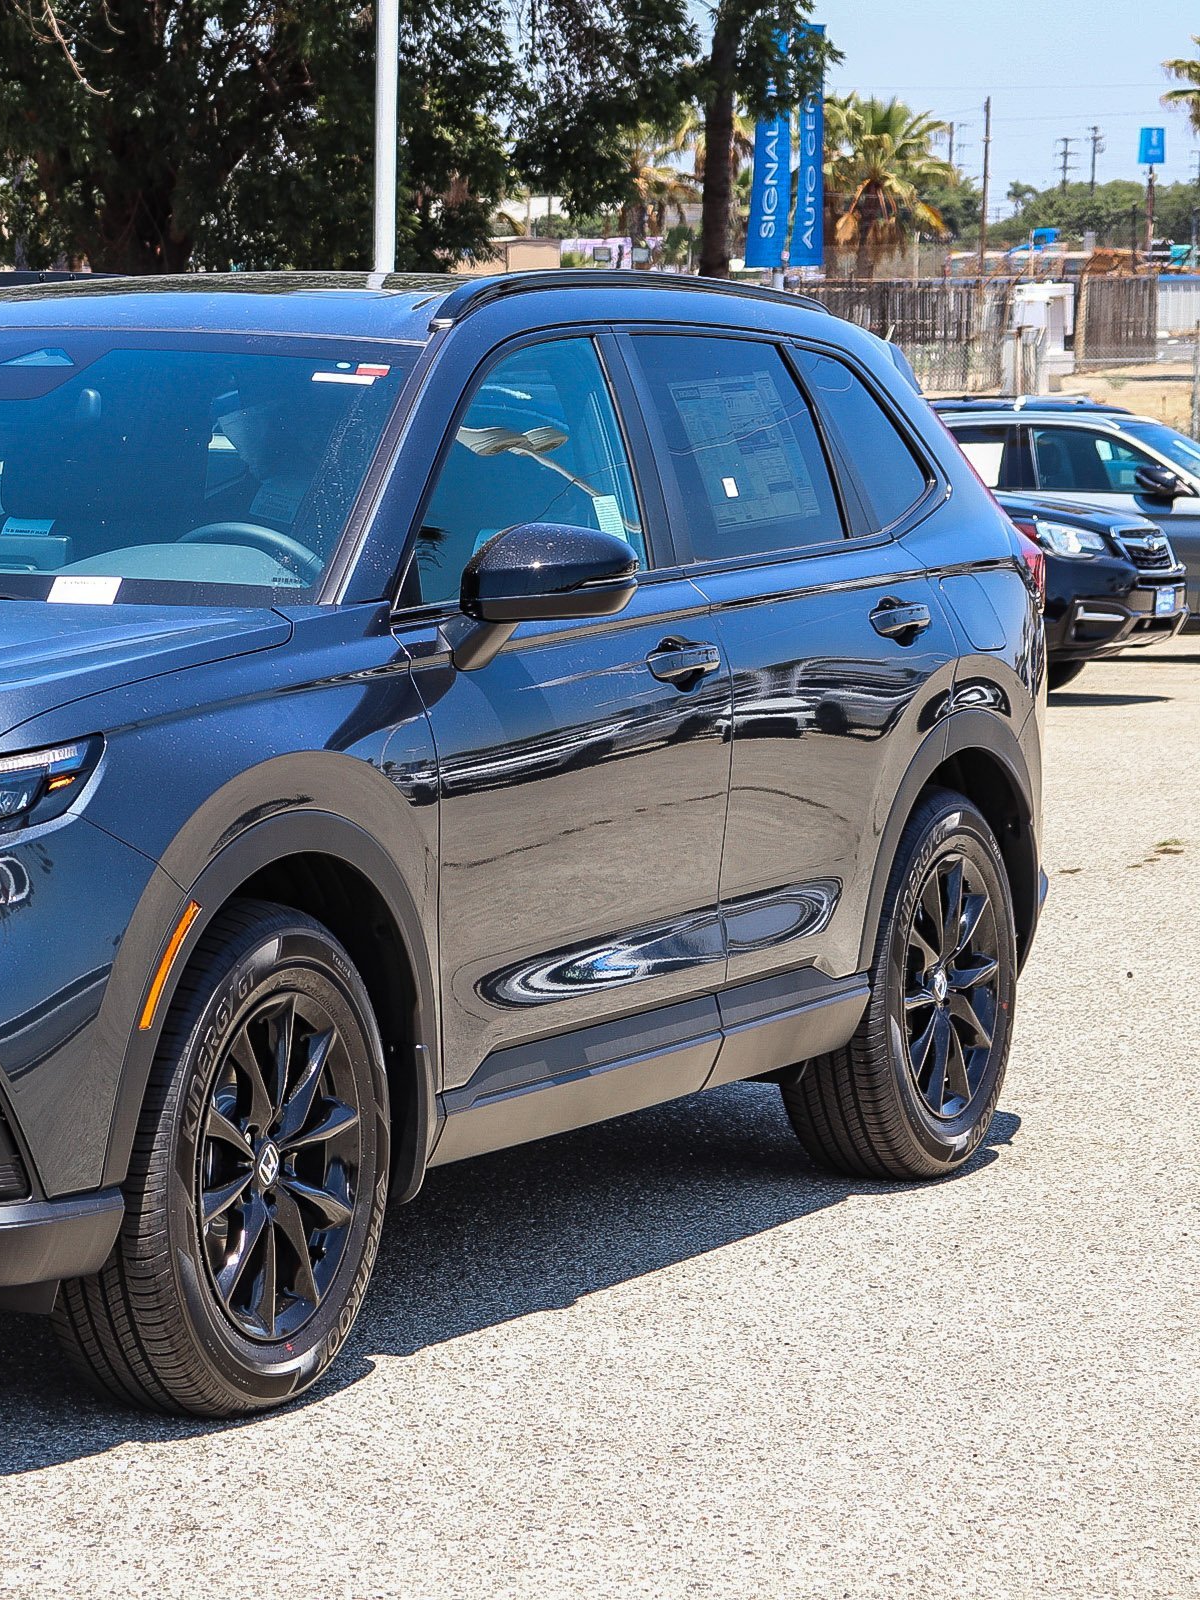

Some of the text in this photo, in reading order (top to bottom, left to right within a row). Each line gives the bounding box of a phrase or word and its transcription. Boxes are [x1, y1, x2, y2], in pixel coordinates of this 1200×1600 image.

[759, 121, 779, 239] SIGNAL
[802, 165, 816, 250] AUTO
[182, 968, 241, 1145] KINERGY
